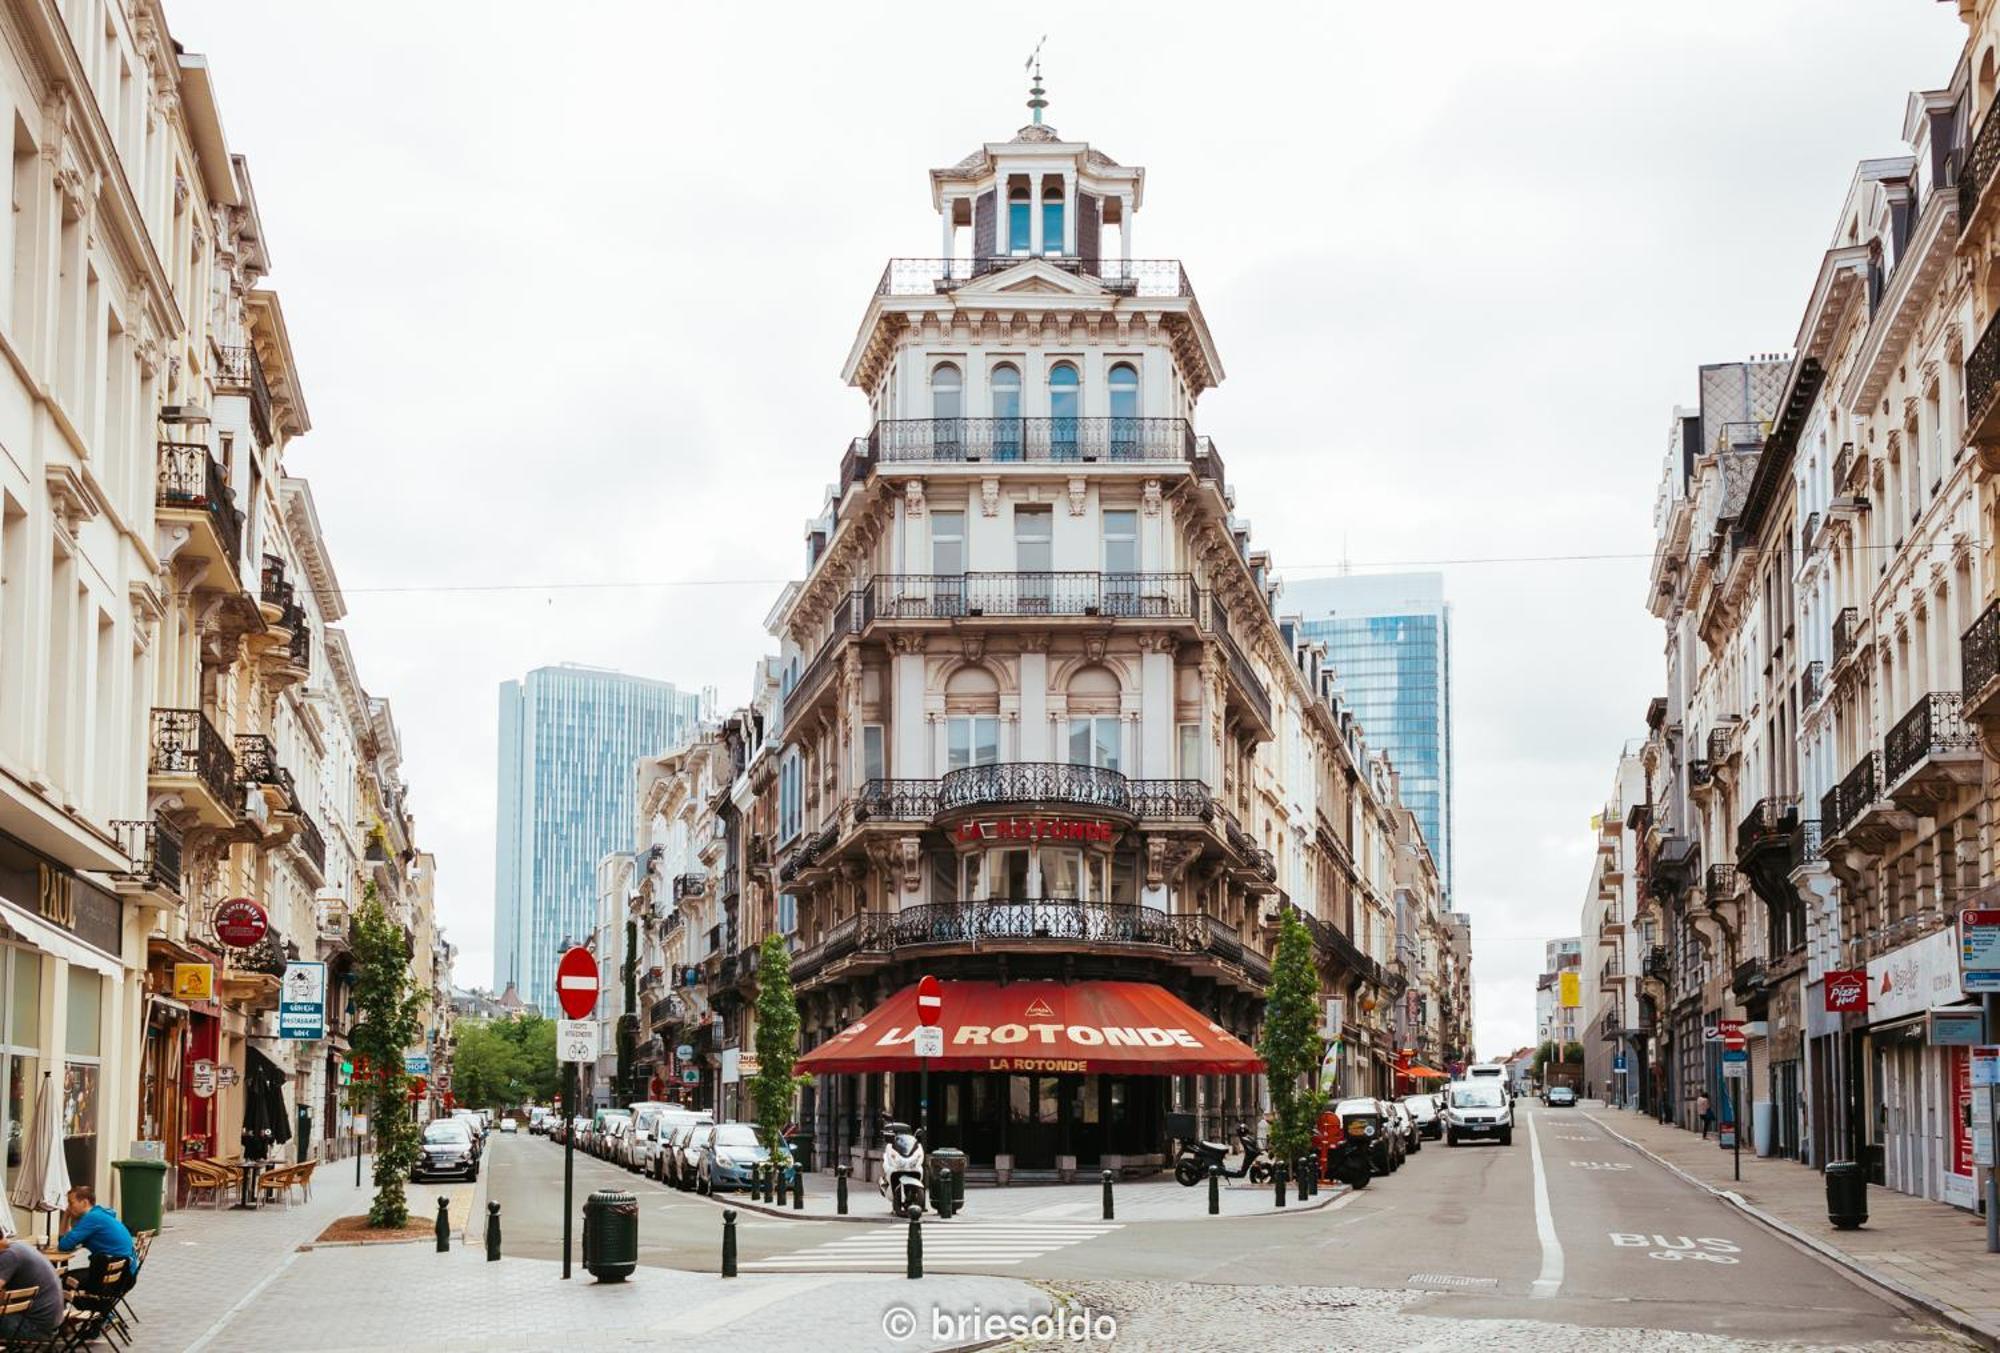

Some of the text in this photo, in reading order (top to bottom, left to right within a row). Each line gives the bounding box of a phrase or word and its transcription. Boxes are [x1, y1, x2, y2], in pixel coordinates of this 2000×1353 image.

[996, 821, 1113, 842] ROTONDE
[40, 863, 76, 930] PAUL
[1830, 985, 1860, 1001] Pizza
[1835, 995, 1859, 1007] Hut
[952, 1023, 1204, 1048] ROTONDE
[989, 1058, 1087, 1073] LA ROTONDE
[1608, 1232, 1742, 1253] BUS
